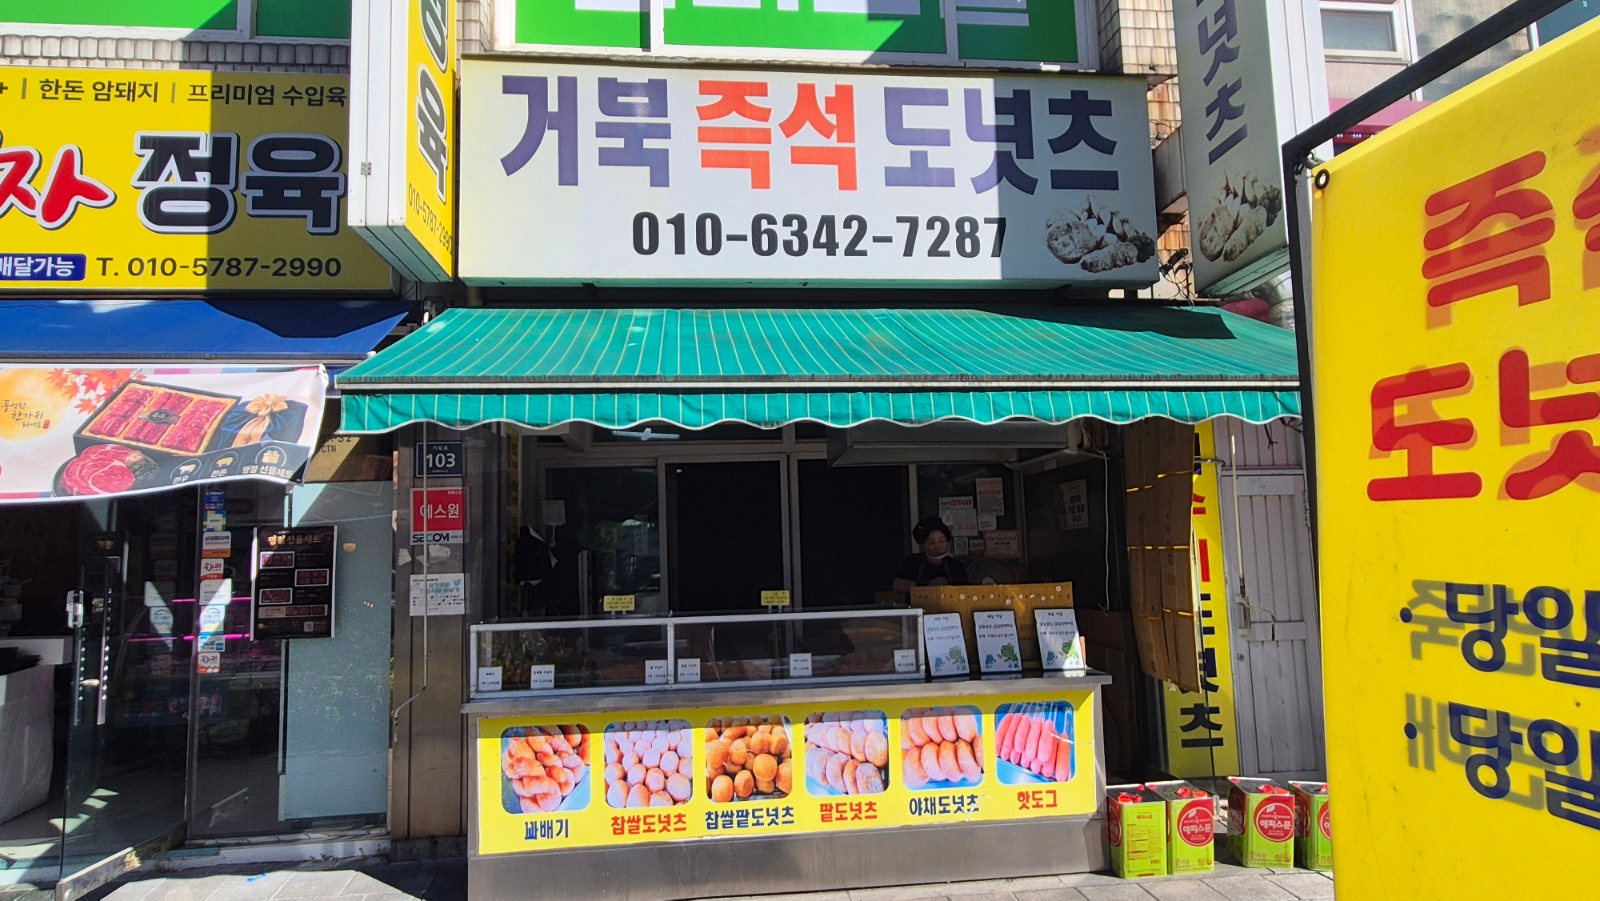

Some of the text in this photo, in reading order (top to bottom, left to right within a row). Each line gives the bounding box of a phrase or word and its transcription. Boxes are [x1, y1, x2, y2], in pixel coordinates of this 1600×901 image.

[39, 79, 159, 103] 한돈 암돼지
[1197, 0, 1248, 165] 넛츠
[186, 83, 347, 107] 프리미엄 수입육
[501, 75, 1120, 196] 거북 즉석 도넛츠
[133, 131, 347, 235] 정육
[632, 211, 1008, 259] 010-6342-7287
[97, 257, 342, 278] T. 010-5787-2990
[426, 453, 456, 468] 103
[420, 503, 460, 519] 에스원
[909, 793, 980, 816] 야채도넛츠
[1017, 789, 1058, 811] 핫도그
[705, 804, 794, 831] 찹쌀팥도넛츠
[819, 801, 878, 823] 팥도넛츠
[524, 818, 570, 841] 꽈배기
[610, 813, 688, 836] 찹쌀도넛츠
